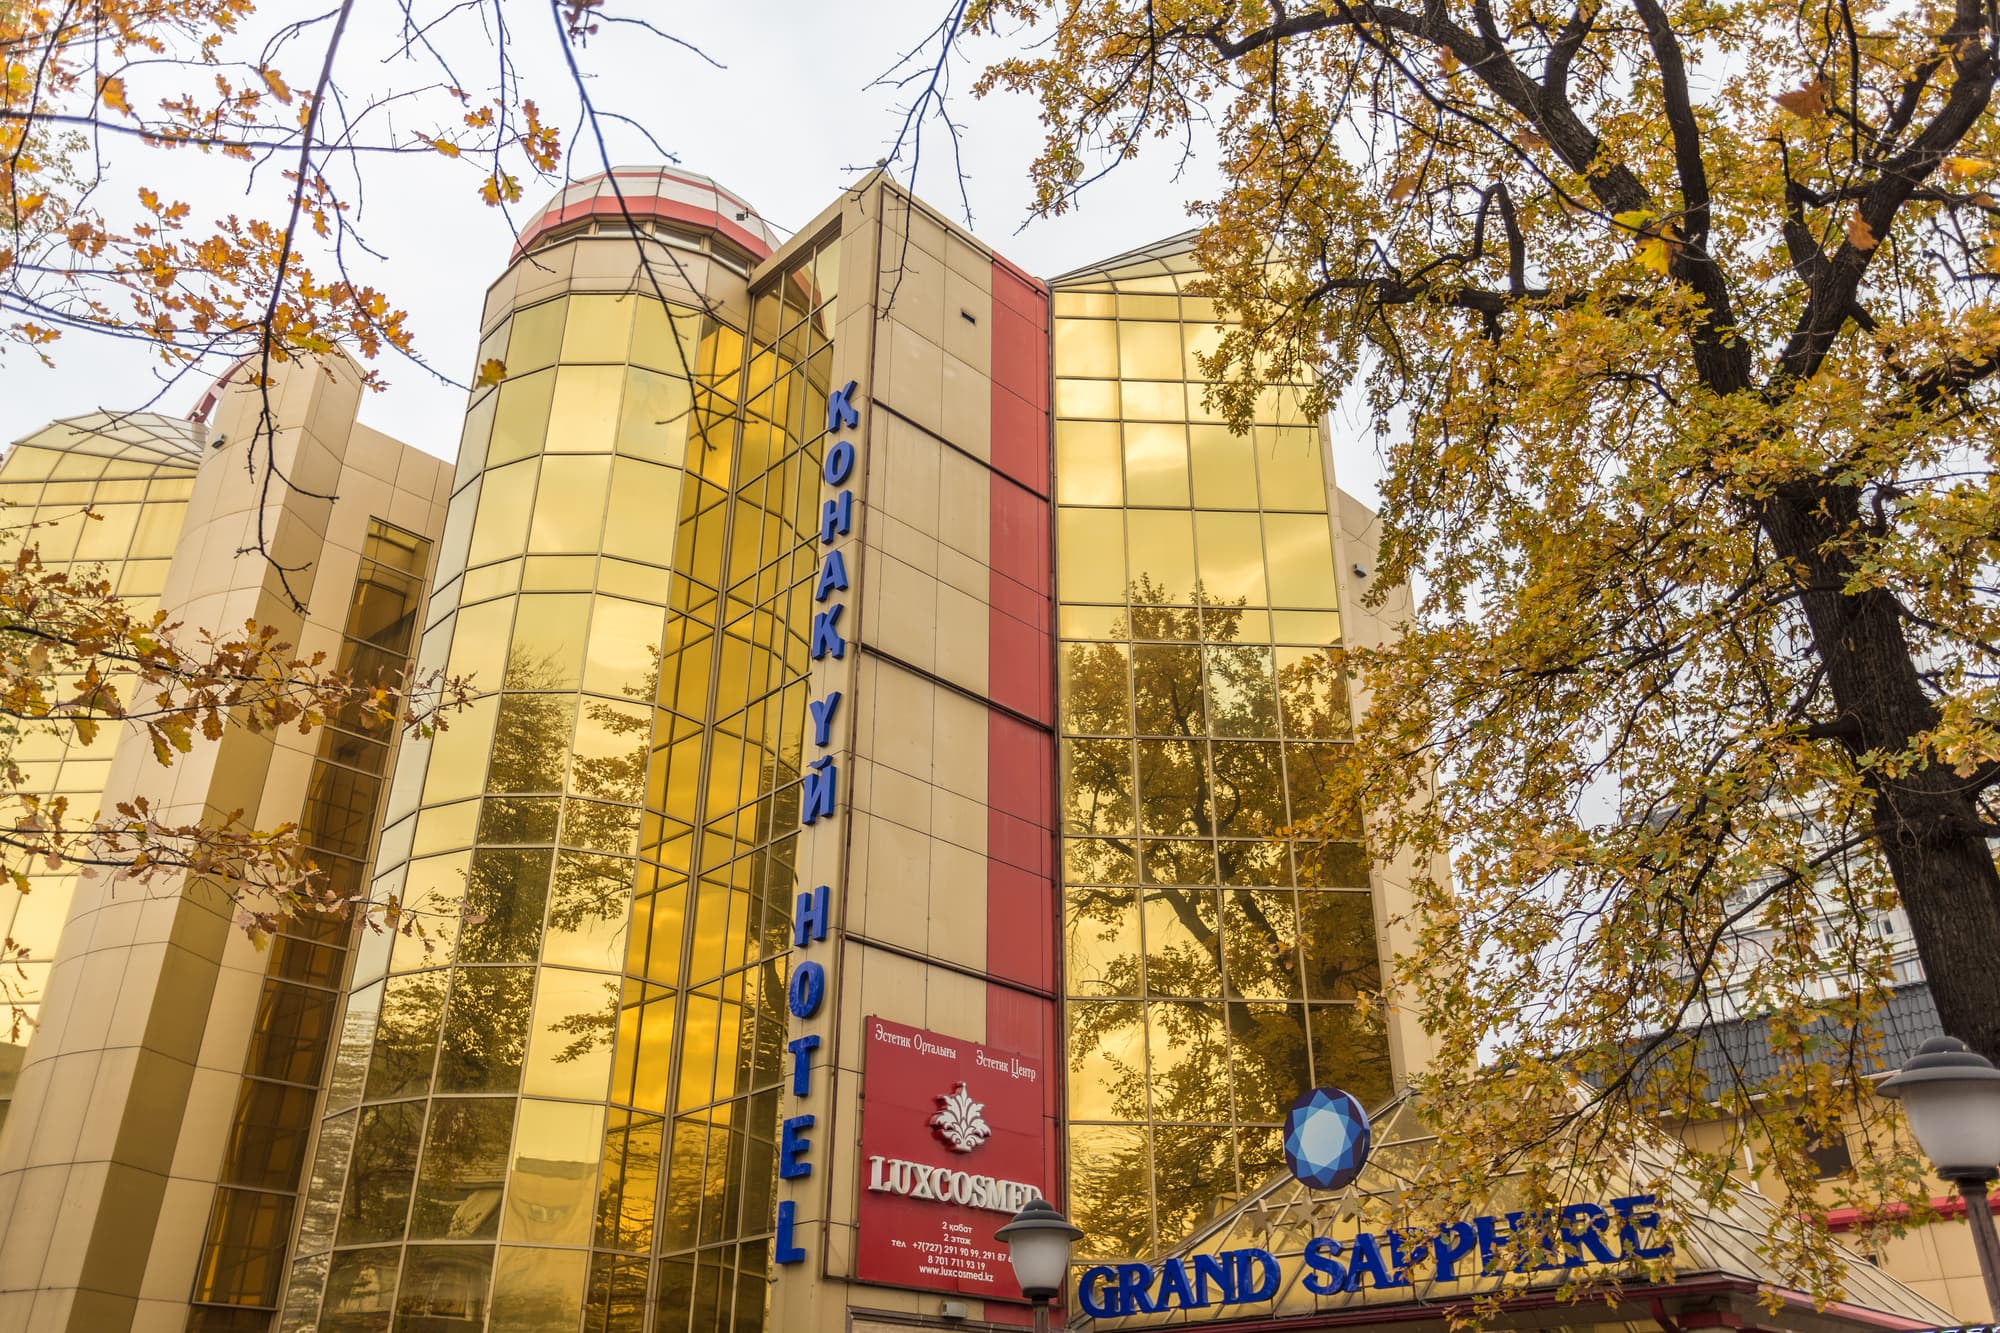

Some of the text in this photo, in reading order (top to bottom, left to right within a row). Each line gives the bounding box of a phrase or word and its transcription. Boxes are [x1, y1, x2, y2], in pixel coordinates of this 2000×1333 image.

[875, 1023, 911, 1049] Эстетик
[775, 885, 830, 1265] HOTEL
[976, 1049, 1037, 1082] Эстетик Центр
[867, 1155, 1044, 1215] LUXCOSMED
[942, 1221, 948, 1230] 2
[943, 1233, 971, 1245] 2 этаж
[927, 1254, 986, 1271] 8 701 711 93 19
[944, 1245, 958, 1256] 291
[960, 1247, 969, 1257] 90
[982, 1250, 996, 1261] 291
[997, 1253, 1007, 1262] 87
[919, 1264, 994, 1282] www.luxcosmed.kz
[1078, 1248, 1281, 1319] GRAND
